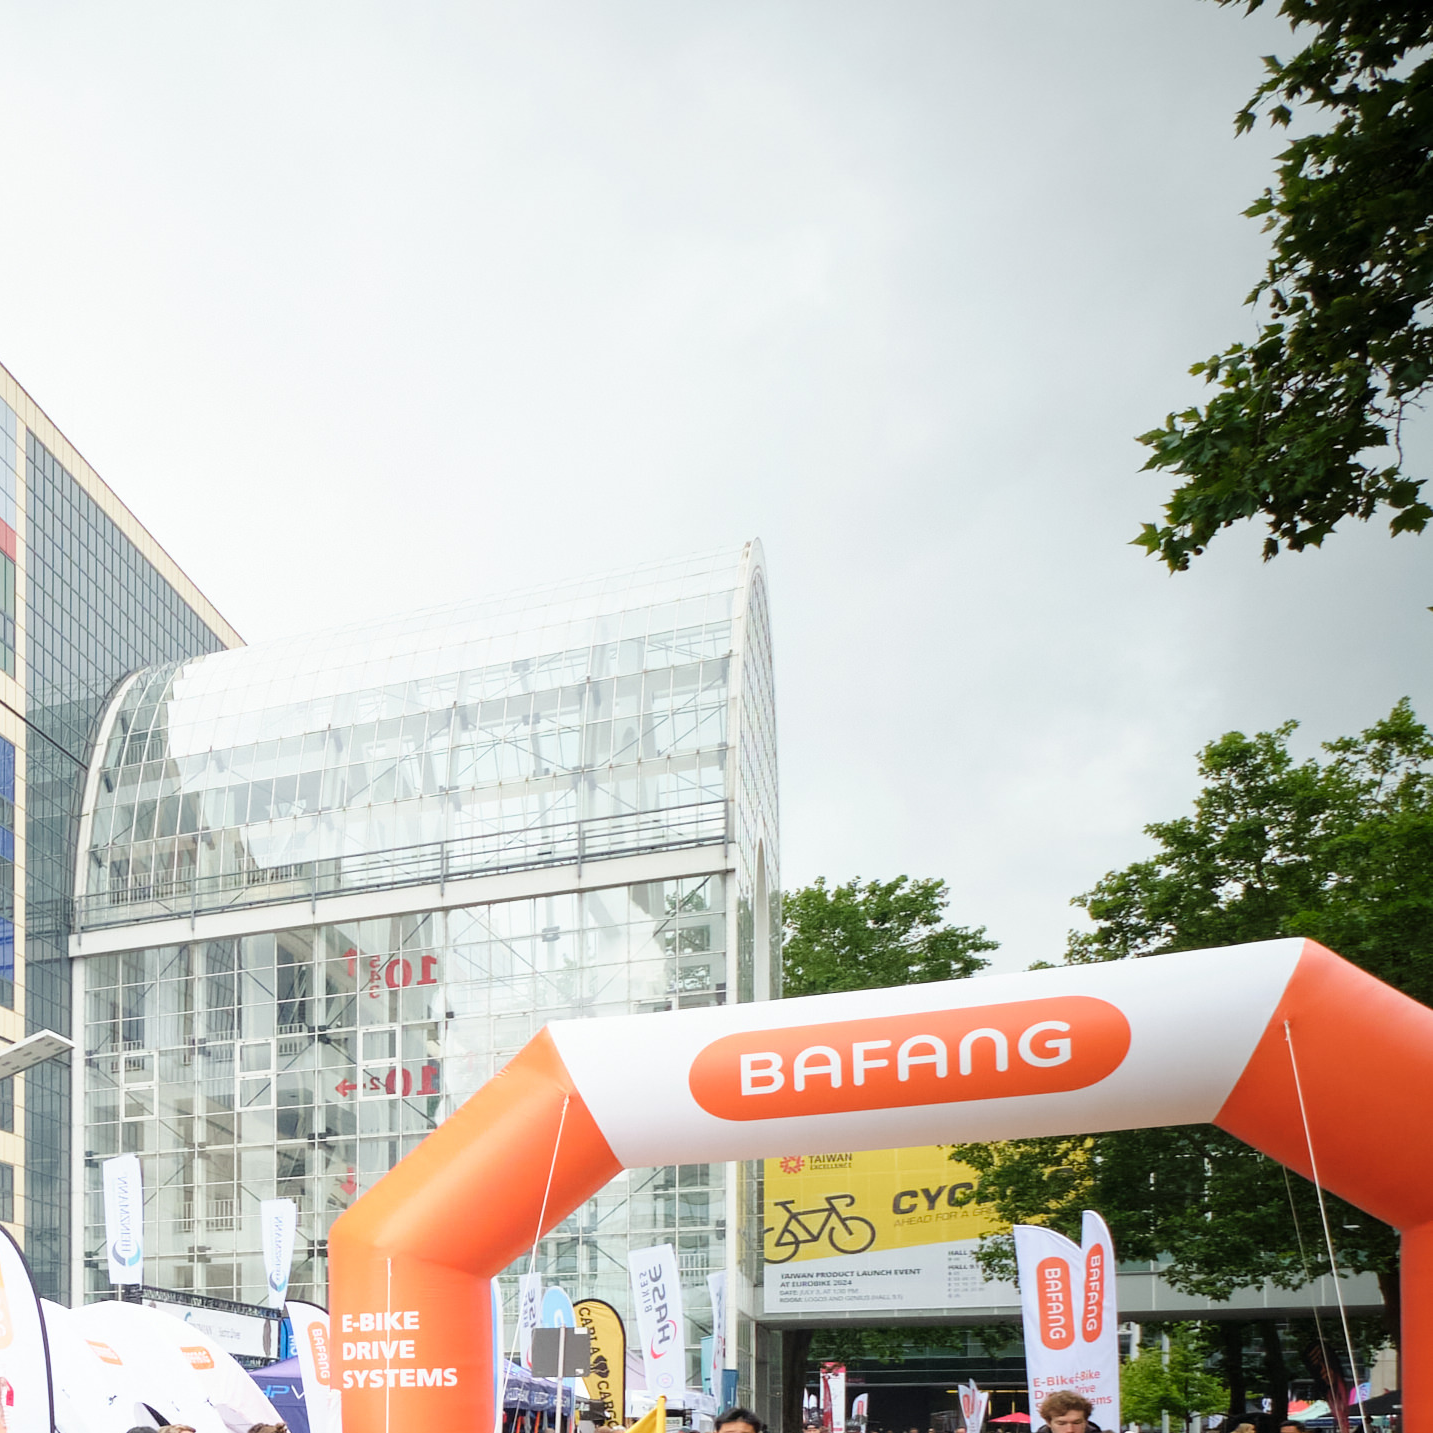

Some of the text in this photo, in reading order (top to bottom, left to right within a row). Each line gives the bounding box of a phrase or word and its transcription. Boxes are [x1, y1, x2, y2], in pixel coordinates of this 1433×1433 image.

[739, 1020, 1072, 1097] BAFANG
[808, 1152, 853, 1164] TAIWAN
[894, 1214, 932, 1227] AHEAD
[935, 1211, 958, 1222] FOR
[816, 1271, 855, 1279] PRODUCT
[856, 1269, 892, 1277] LAUNCH
[894, 1268, 921, 1276] EVENT
[1044, 1267, 1066, 1340] BAFANG
[1086, 1254, 1101, 1332] BAFANG
[341, 1311, 420, 1333] E-BIKE
[311, 1327, 331, 1379] BAFANG
[342, 1339, 416, 1361] DRIVE
[342, 1368, 458, 1389] SYSTEMS
